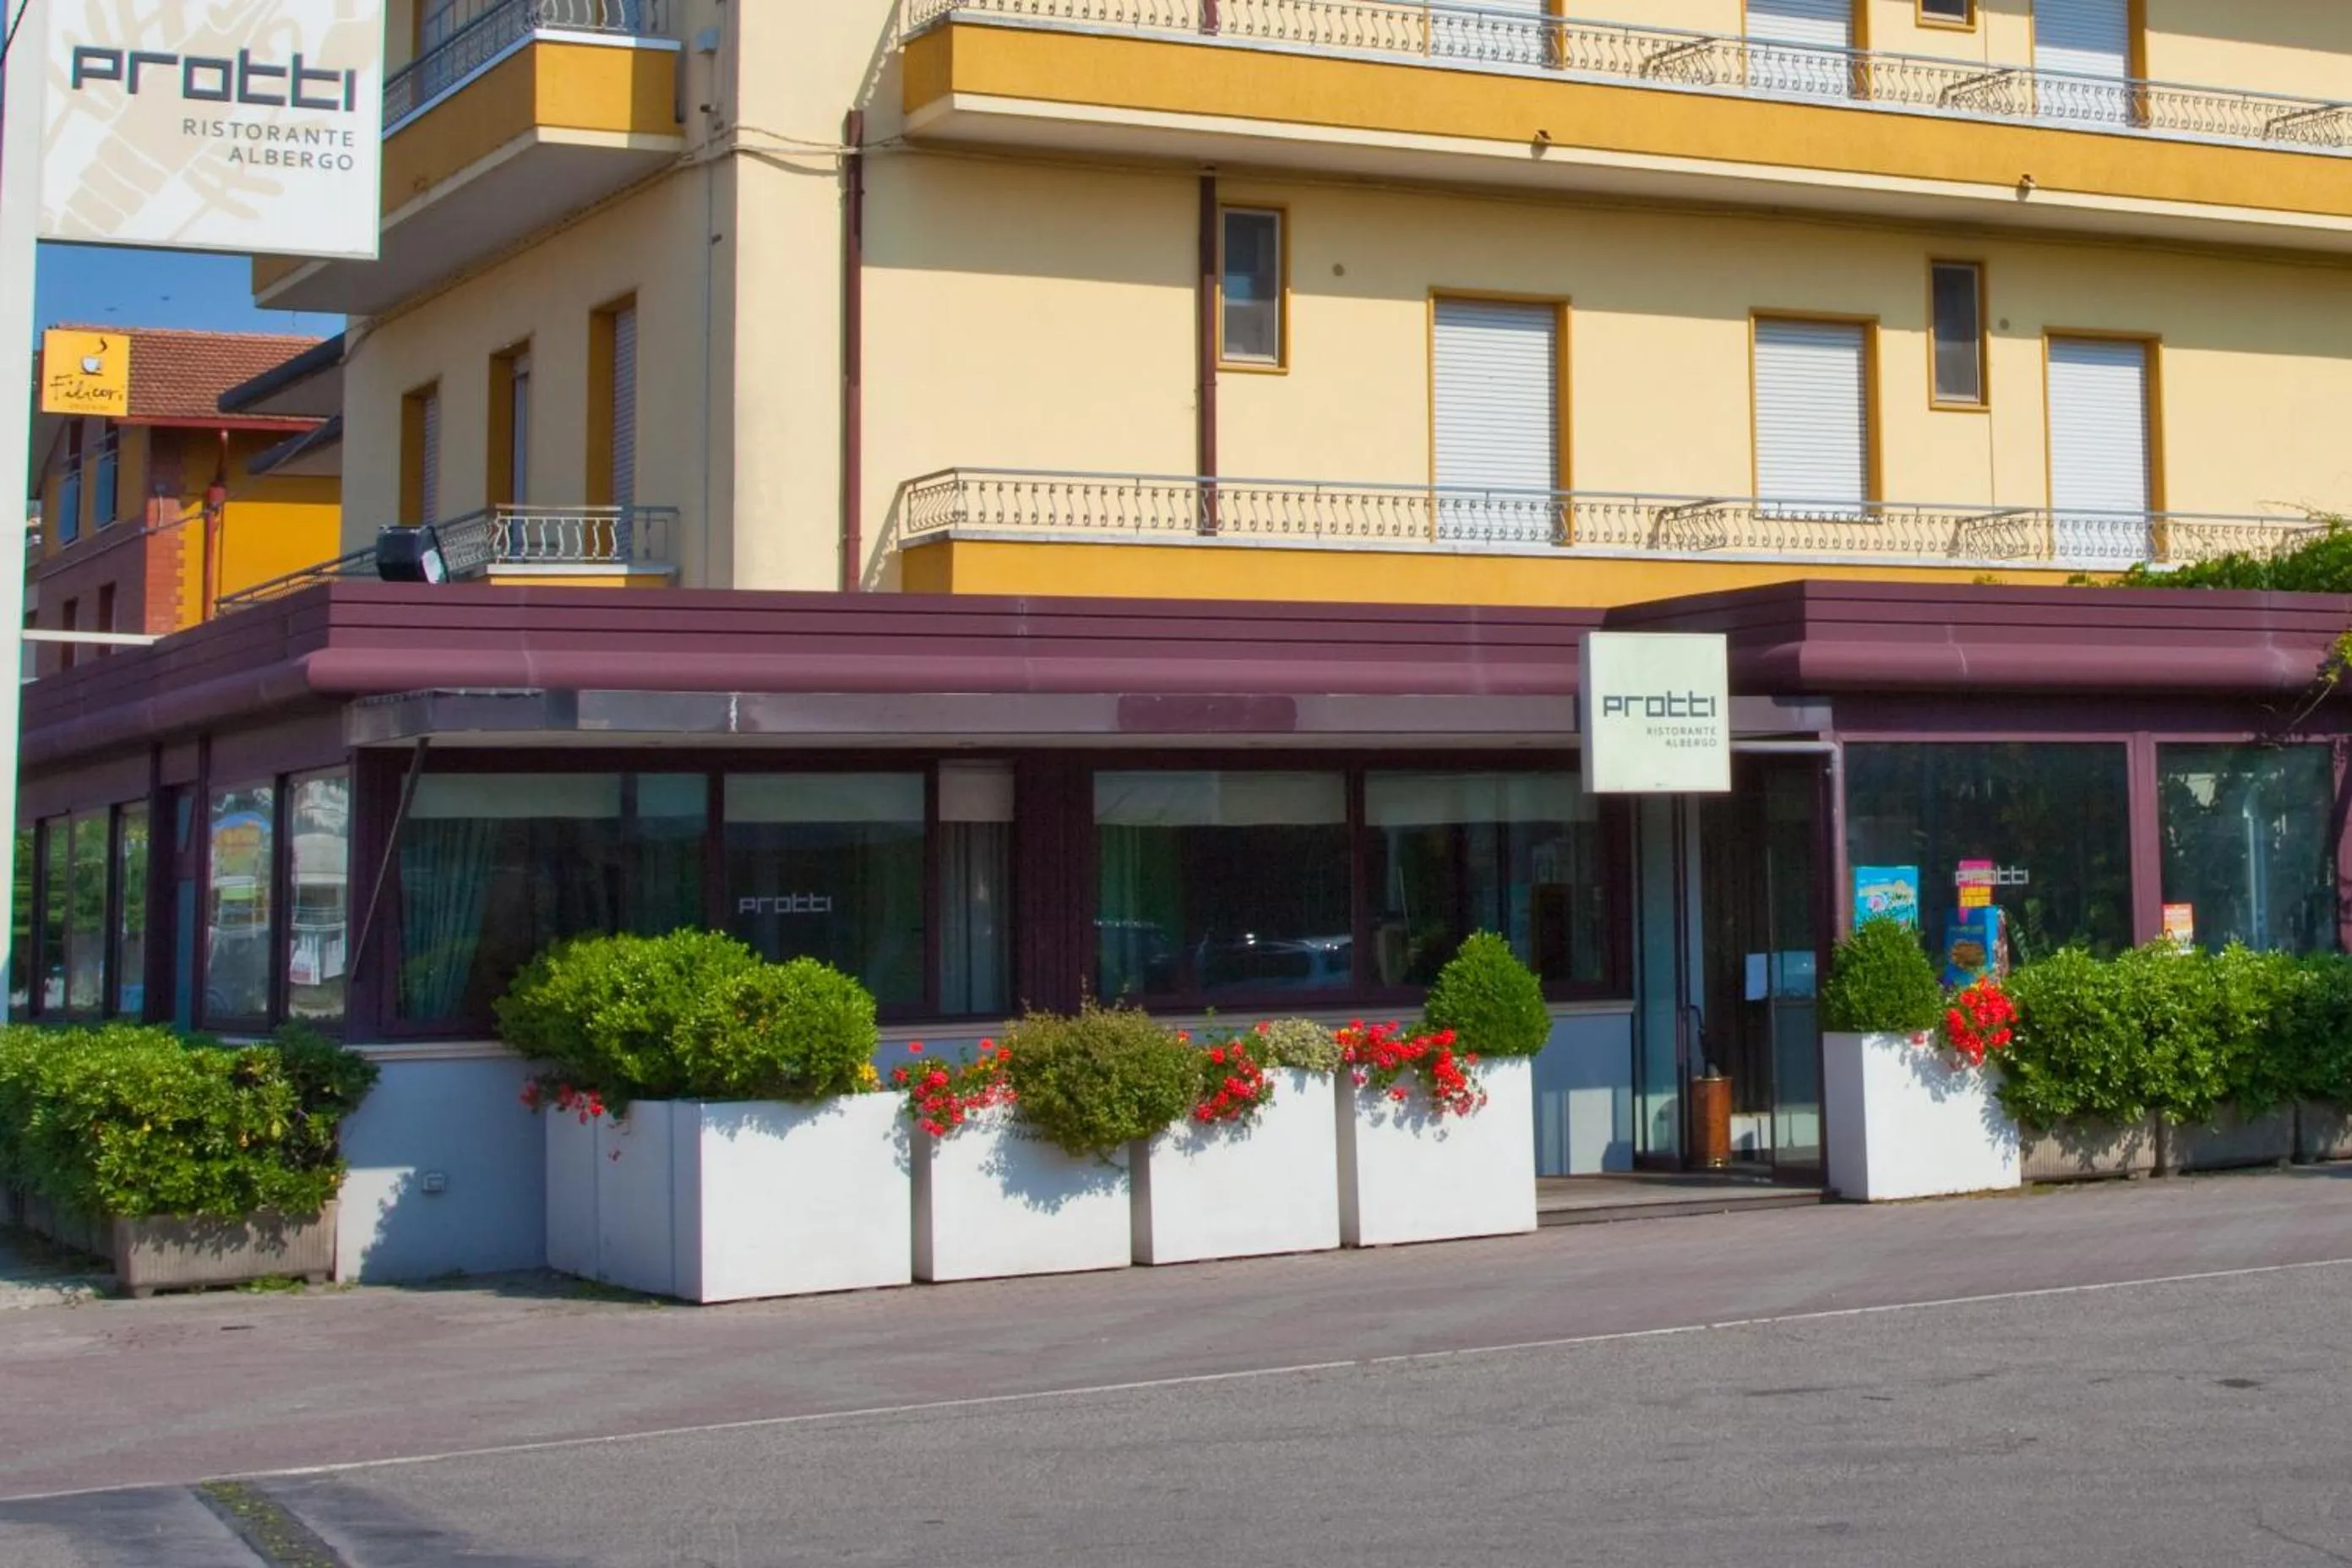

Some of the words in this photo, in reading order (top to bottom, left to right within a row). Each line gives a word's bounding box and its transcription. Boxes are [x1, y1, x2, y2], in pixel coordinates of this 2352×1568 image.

[72, 46, 357, 112] protti
[182, 118, 355, 148] RISTORANTE
[229, 147, 354, 171] ALBERGO
[1603, 690, 1716, 717] protti
[1647, 727, 1717, 737] RISTORANTE
[1665, 738, 1717, 748] ALBERGO
